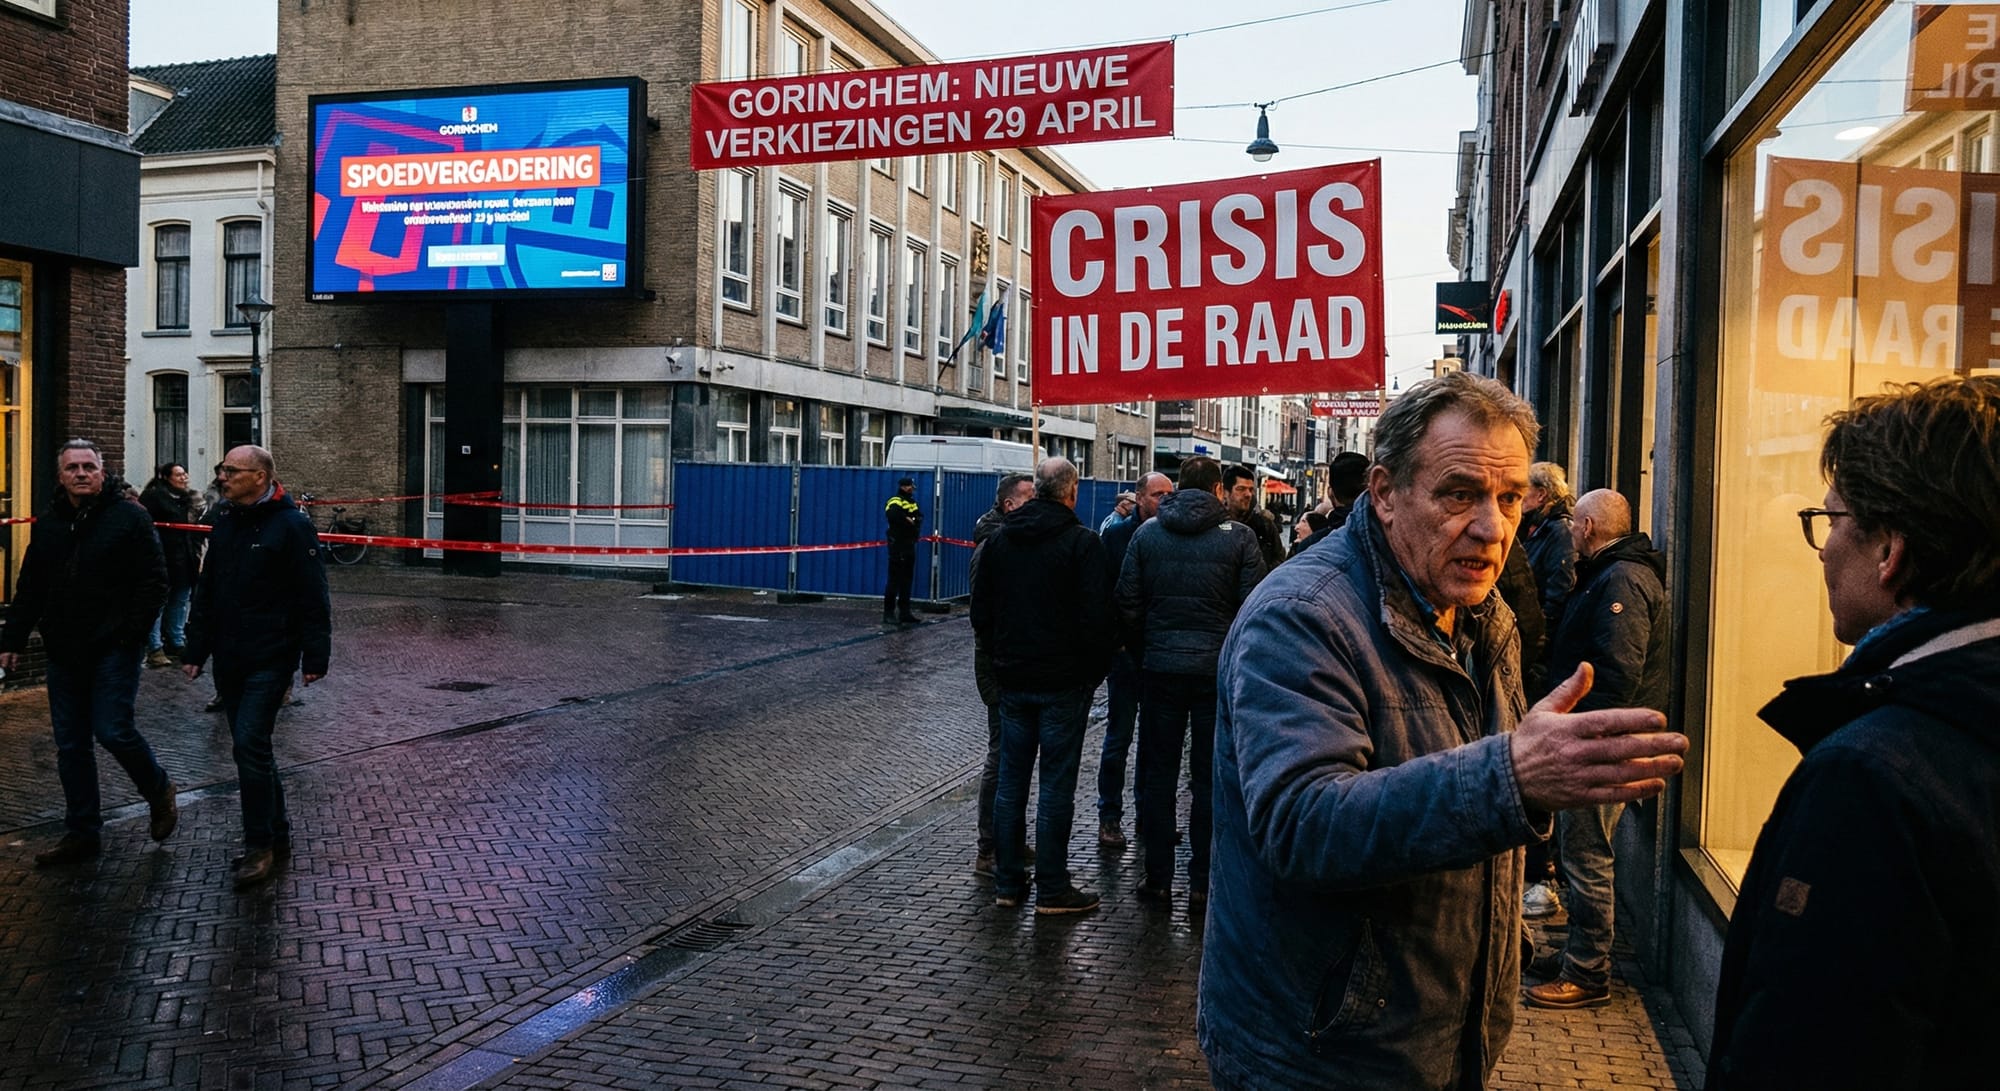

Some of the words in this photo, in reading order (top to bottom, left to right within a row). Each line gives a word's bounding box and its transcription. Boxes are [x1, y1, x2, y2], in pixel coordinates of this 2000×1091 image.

[729, 71, 961, 118] GORINCHEM:
[975, 54, 1128, 99] NIEUWE
[440, 123, 498, 135] GORINCHEM
[705, 111, 972, 158] VERKIEZINGEN
[984, 106, 1025, 140] 29
[1037, 95, 1156, 136] APRIL
[347, 155, 593, 188] SPOEDVERGADERING
[1050, 182, 1366, 297] CRISIS
[1051, 314, 1099, 375] IN
[1120, 308, 1184, 372] DE
[1205, 296, 1366, 367] RAAD
